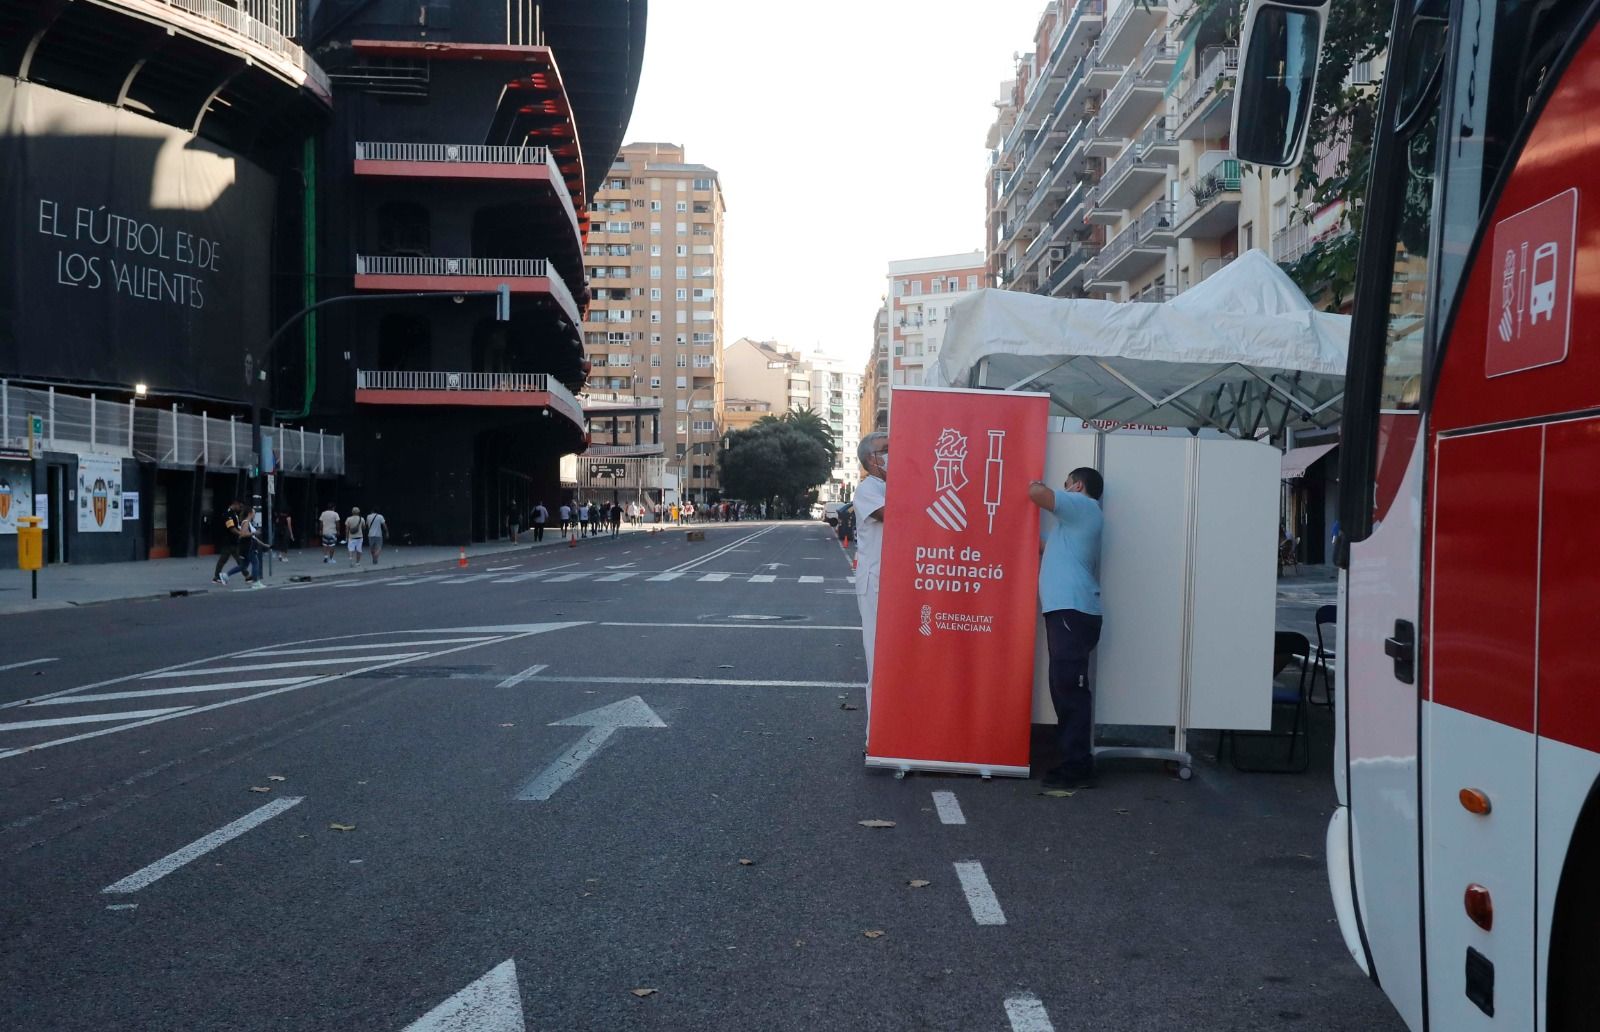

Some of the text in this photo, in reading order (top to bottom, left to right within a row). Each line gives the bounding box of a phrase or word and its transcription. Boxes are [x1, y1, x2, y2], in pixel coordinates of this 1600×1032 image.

[39, 199, 221, 272] EL FÚTBOL ES DE
[58, 250, 205, 310] LOS VALIENTES
[616, 468, 624, 476] 52
[916, 545, 981, 562] punt de
[915, 562, 1004, 580] vacunació
[914, 577, 981, 593] COVID19
[935, 612, 993, 624] GENERALITAT
[935, 621, 992, 633] VALENCIANA
